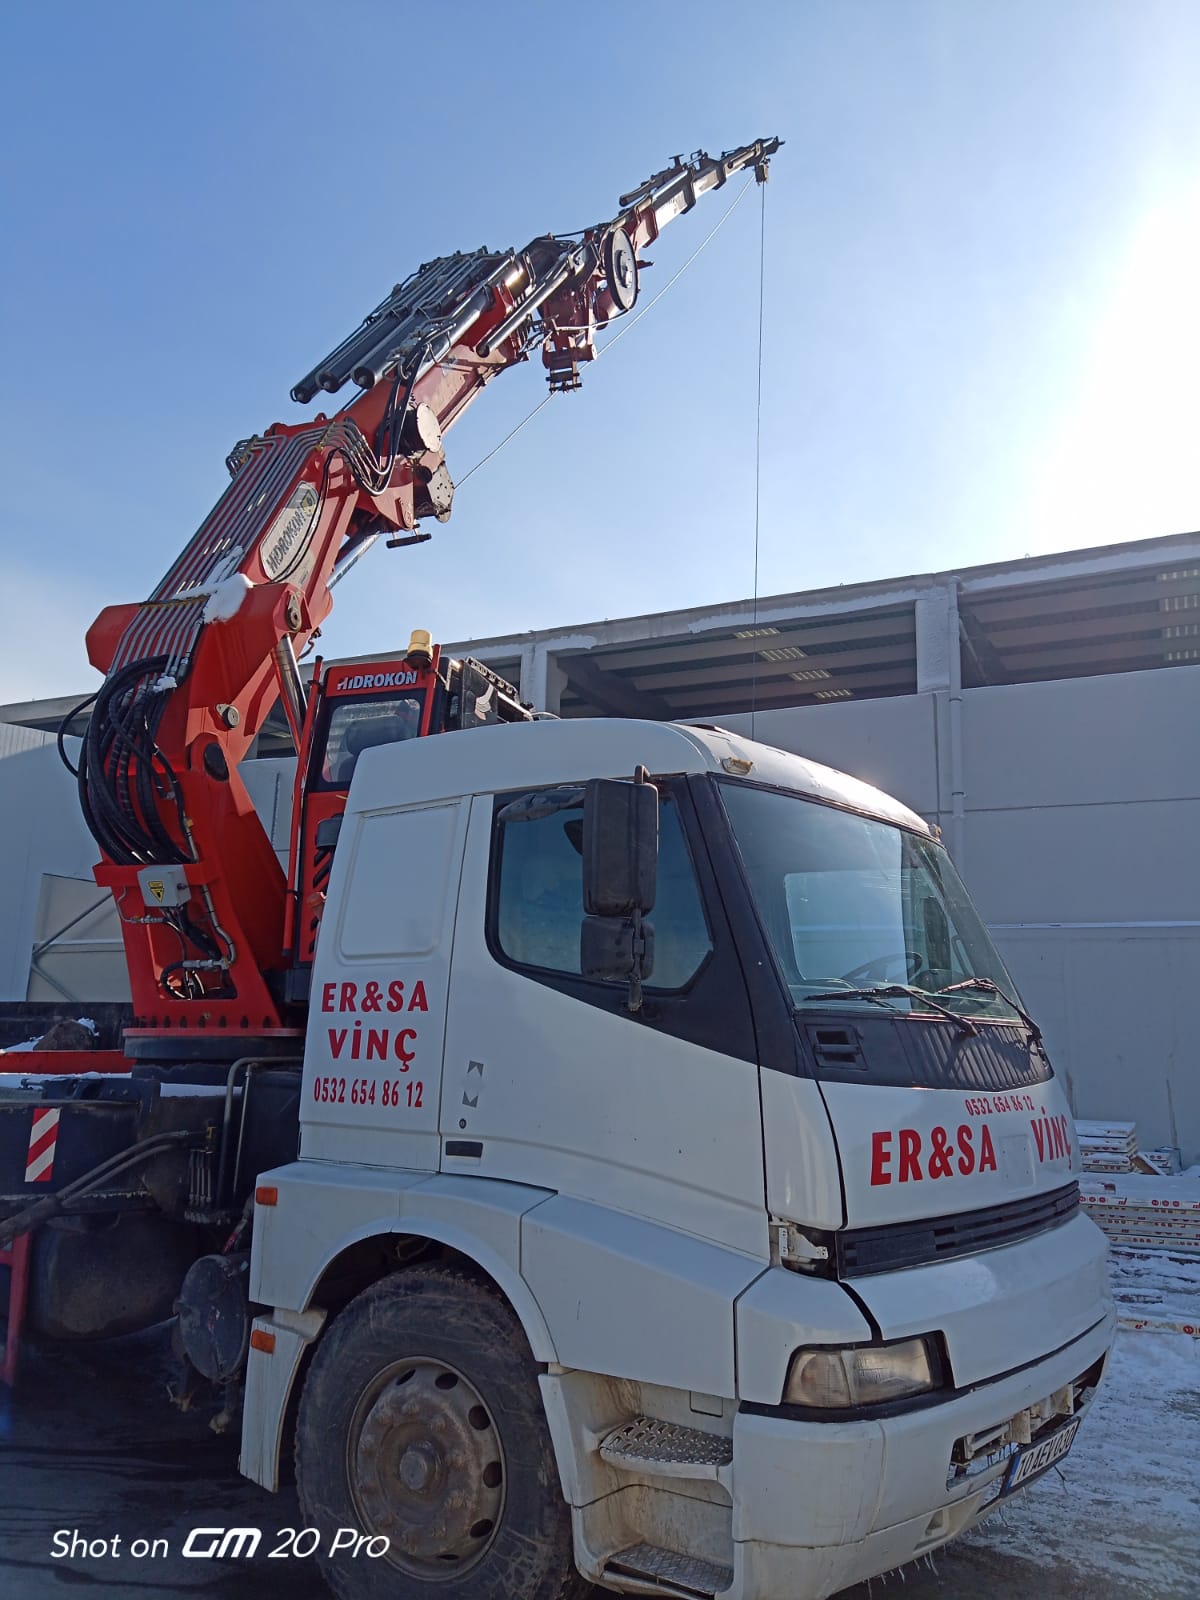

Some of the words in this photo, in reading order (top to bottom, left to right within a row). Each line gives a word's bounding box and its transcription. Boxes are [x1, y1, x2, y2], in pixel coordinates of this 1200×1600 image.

[321, 980, 429, 1013] ER&SA
[327, 1020, 417, 1072] VİNÇ
[313, 1077, 346, 1104] 0532
[351, 1079, 376, 1105] 654
[381, 1080, 399, 1107] 86
[406, 1081, 424, 1108] 12
[965, 1098, 993, 1116] 0532
[992, 1096, 1011, 1113] 654
[1010, 1094, 1023, 1112] 86
[1022, 1095, 1035, 1111] 12
[870, 1124, 997, 1186] ER&SA
